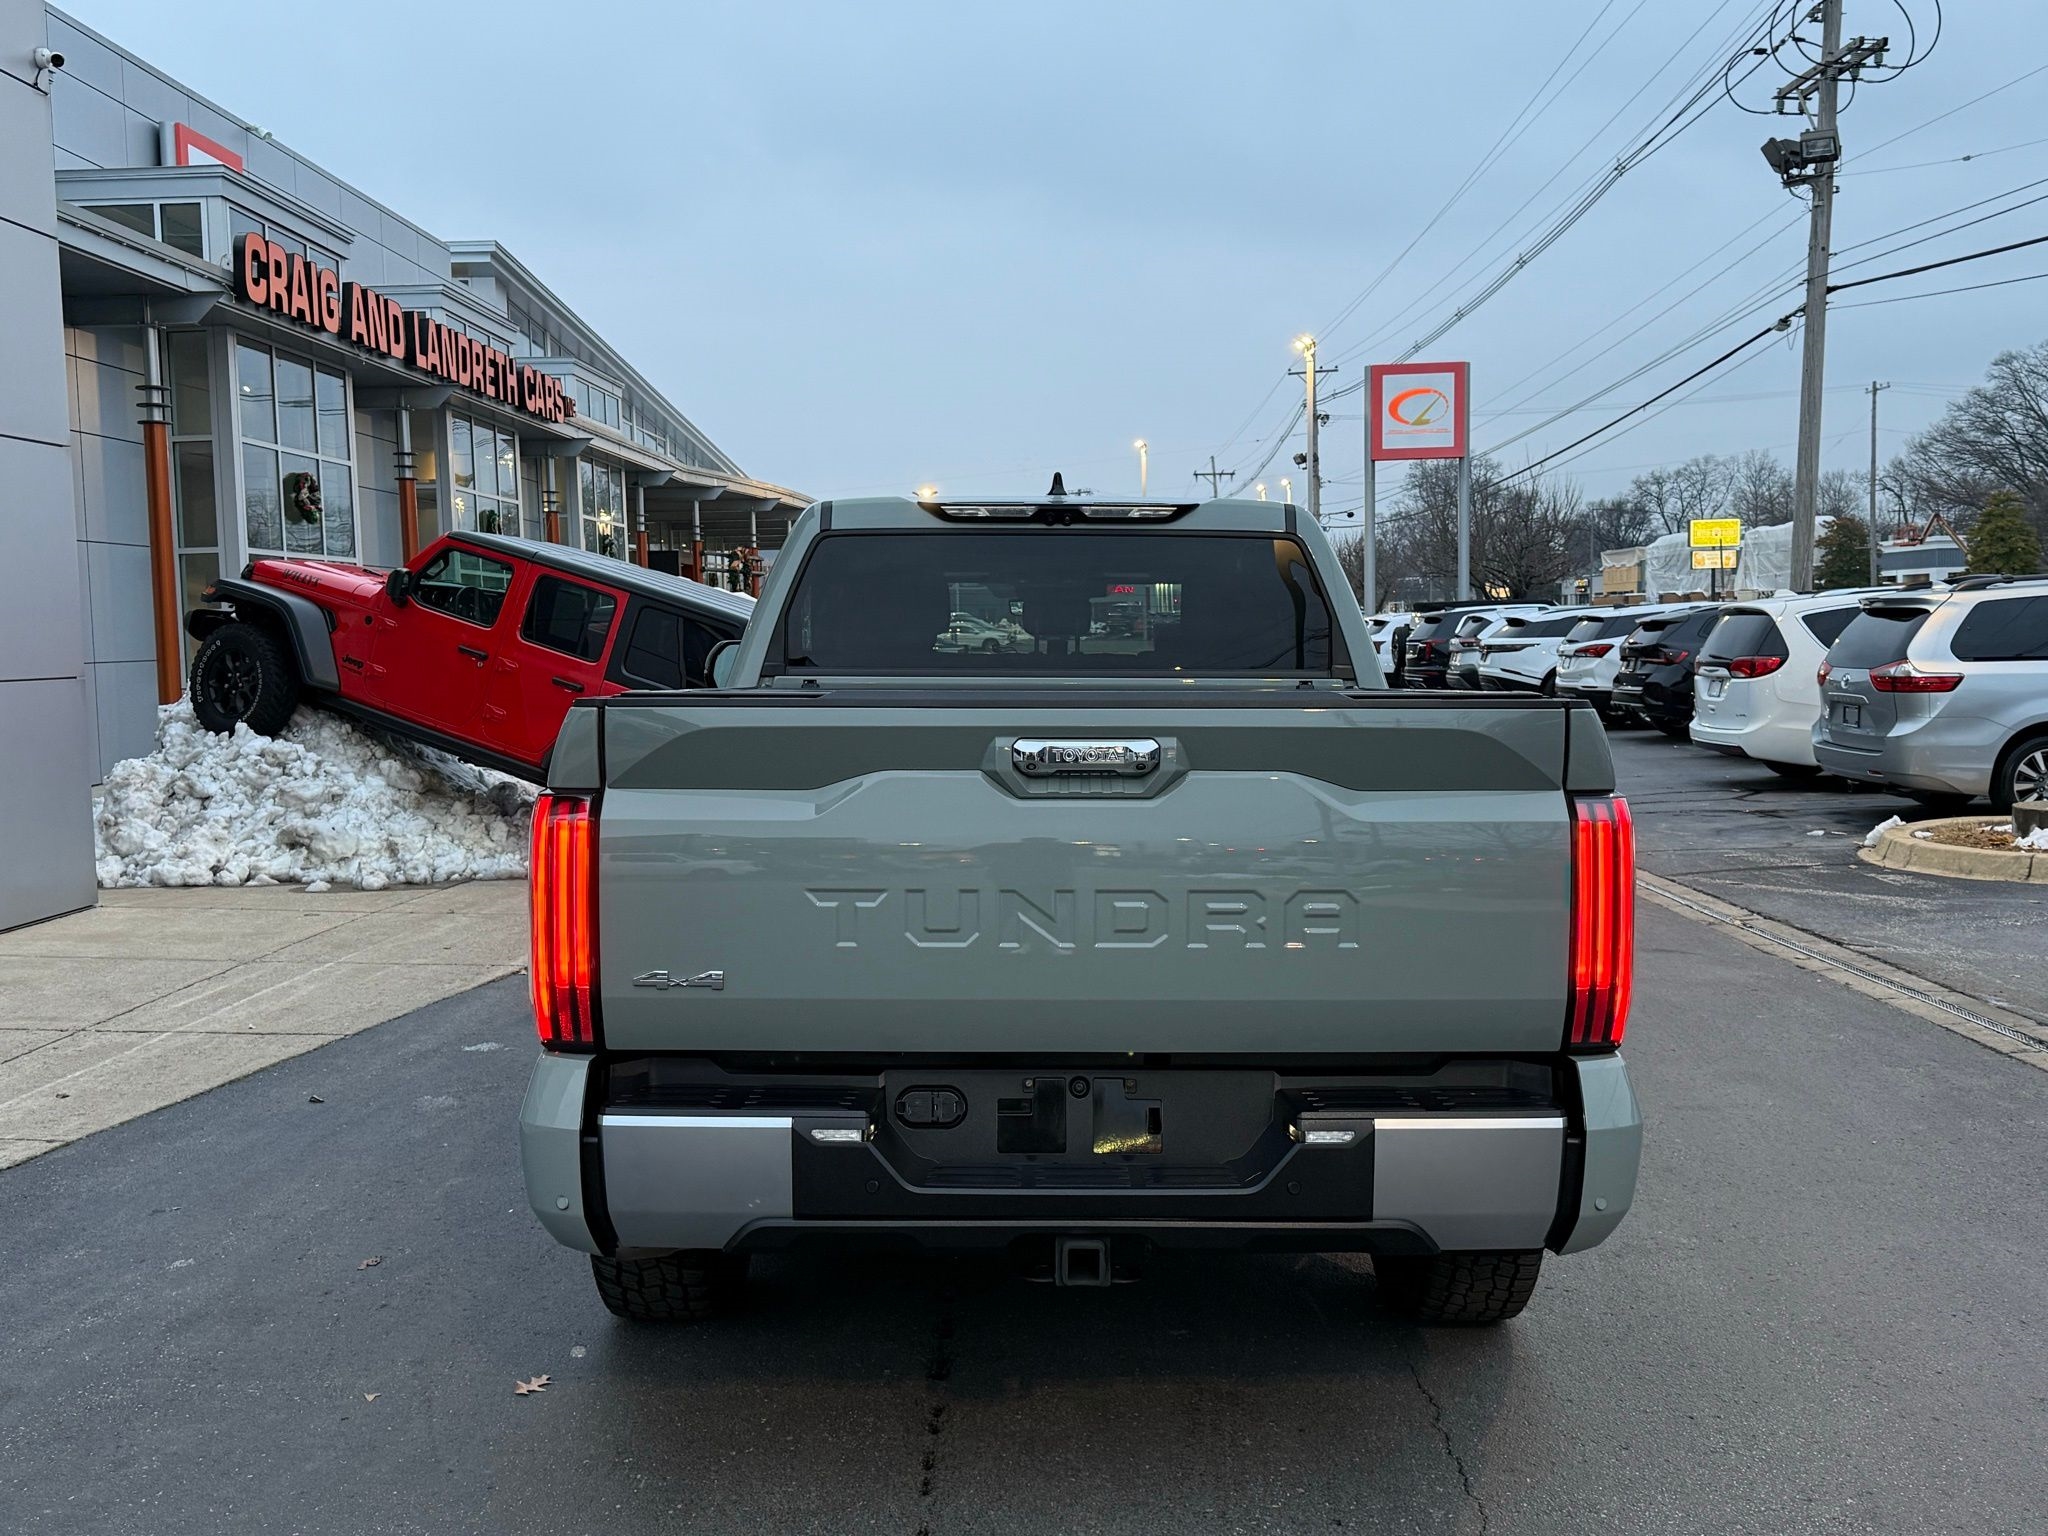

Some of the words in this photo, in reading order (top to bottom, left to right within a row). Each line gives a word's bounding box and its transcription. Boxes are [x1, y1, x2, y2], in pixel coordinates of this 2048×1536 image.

[243, 231, 340, 334] CRAIG
[351, 281, 406, 361] AND
[413, 310, 519, 407] LANDRETH
[523, 363, 565, 424] CARS
[341, 654, 364, 670] Jeep
[1052, 747, 1120, 763] TOYOTA
[803, 887, 1361, 949] TUNDRA
